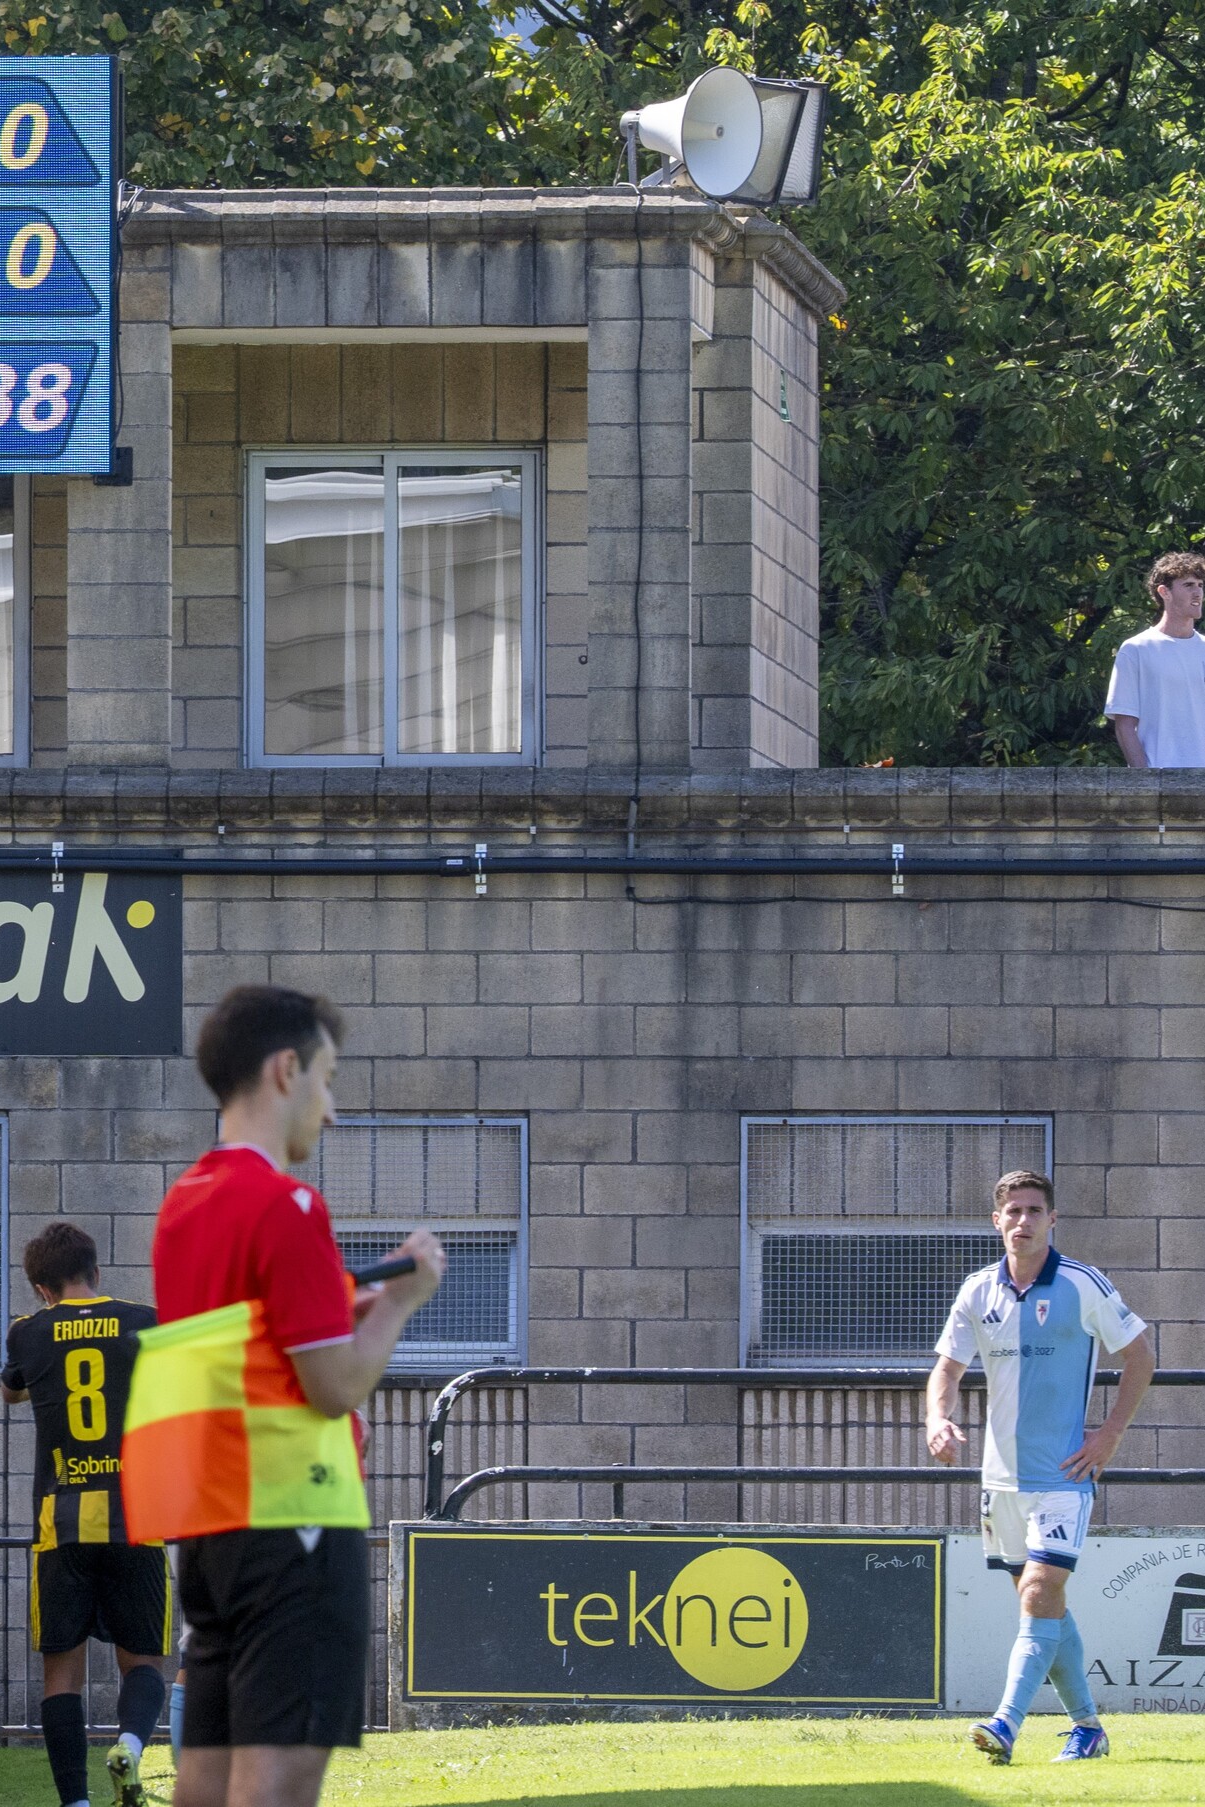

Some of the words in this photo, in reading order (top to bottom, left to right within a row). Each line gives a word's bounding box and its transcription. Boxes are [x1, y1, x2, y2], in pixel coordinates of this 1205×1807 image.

[6, 222, 58, 289] 0
[53, 1317, 120, 1342] ERDOZIA
[65, 1348, 107, 1442] 8
[1102, 1550, 1169, 1600] COMPAÑIA
[540, 1569, 794, 1649] teknei
[1133, 1697, 1205, 1712] FUNDAD
